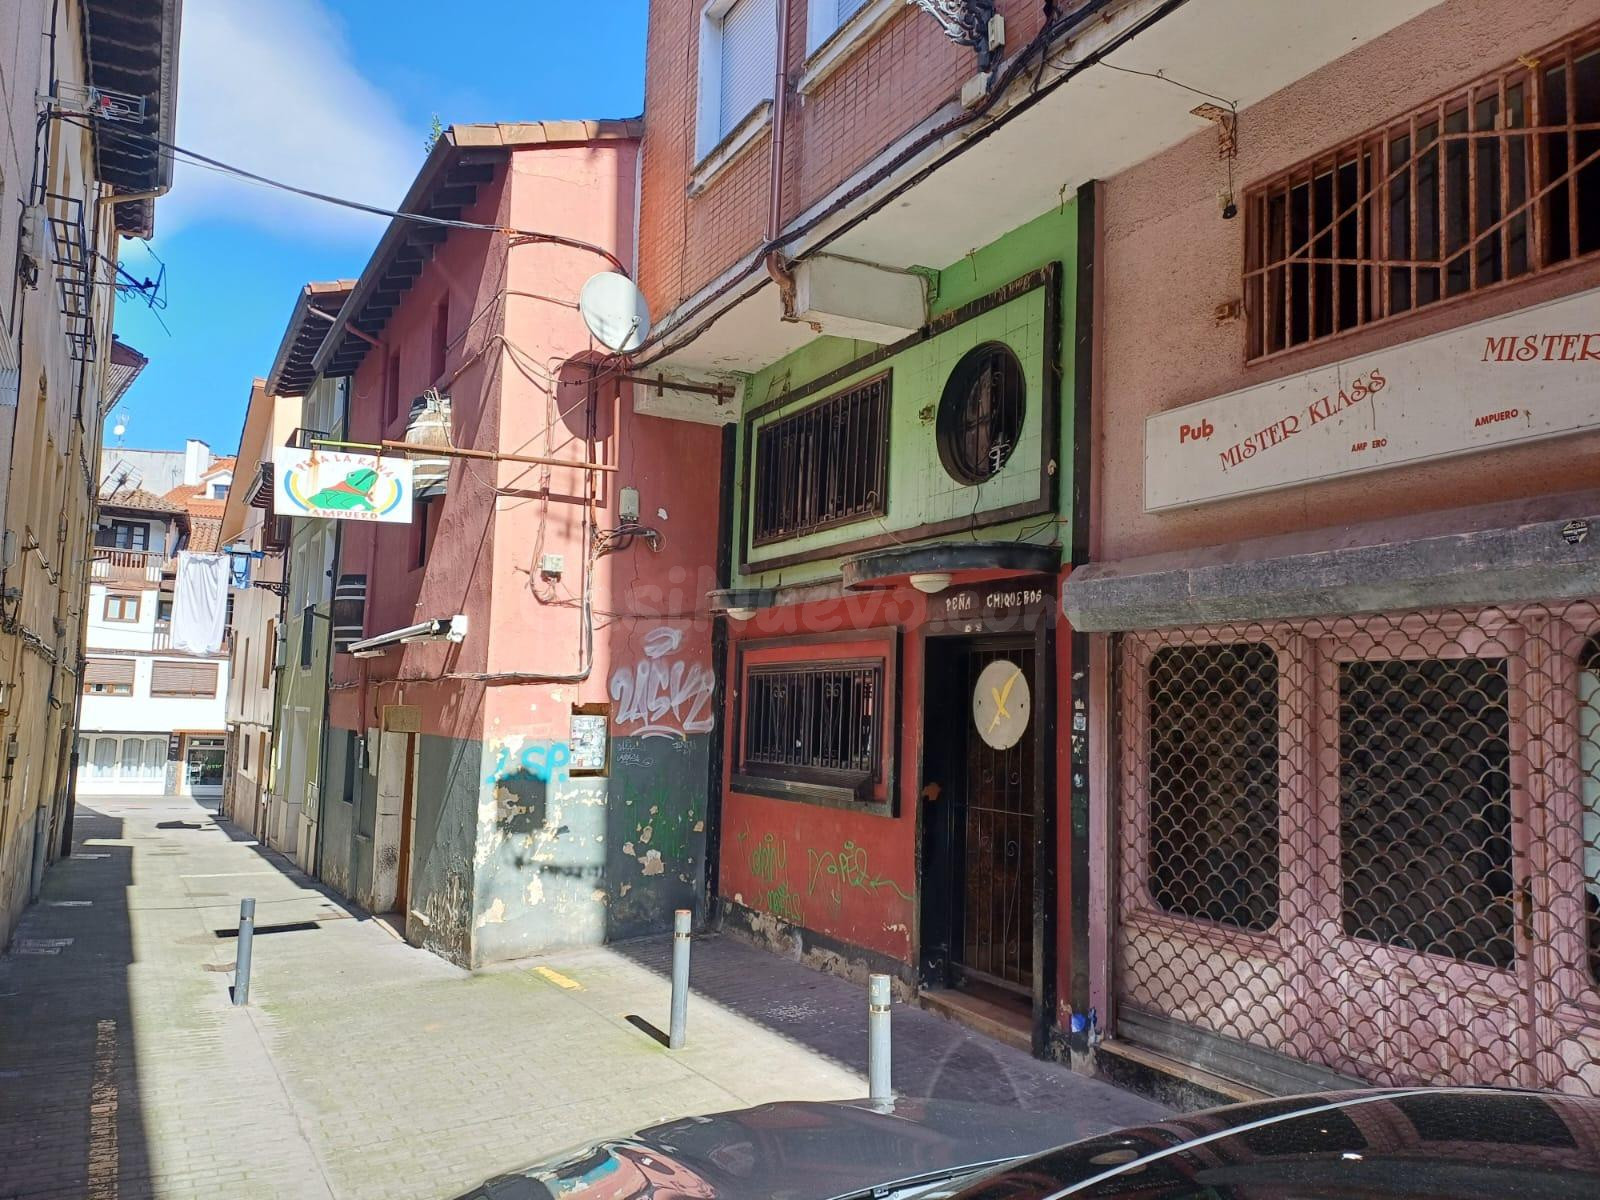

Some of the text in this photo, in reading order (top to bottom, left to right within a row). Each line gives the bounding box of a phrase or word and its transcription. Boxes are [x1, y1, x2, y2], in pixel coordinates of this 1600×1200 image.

[1219, 368, 1386, 471] MISTER KLASS
[1474, 408, 1519, 427] AMPUERO
[1180, 418, 1214, 444] Pub
[295, 455, 329, 472] PEA
[334, 454, 352, 463] LA
[312, 508, 379, 520] AMPUERO
[945, 593, 971, 612] PEÑA
